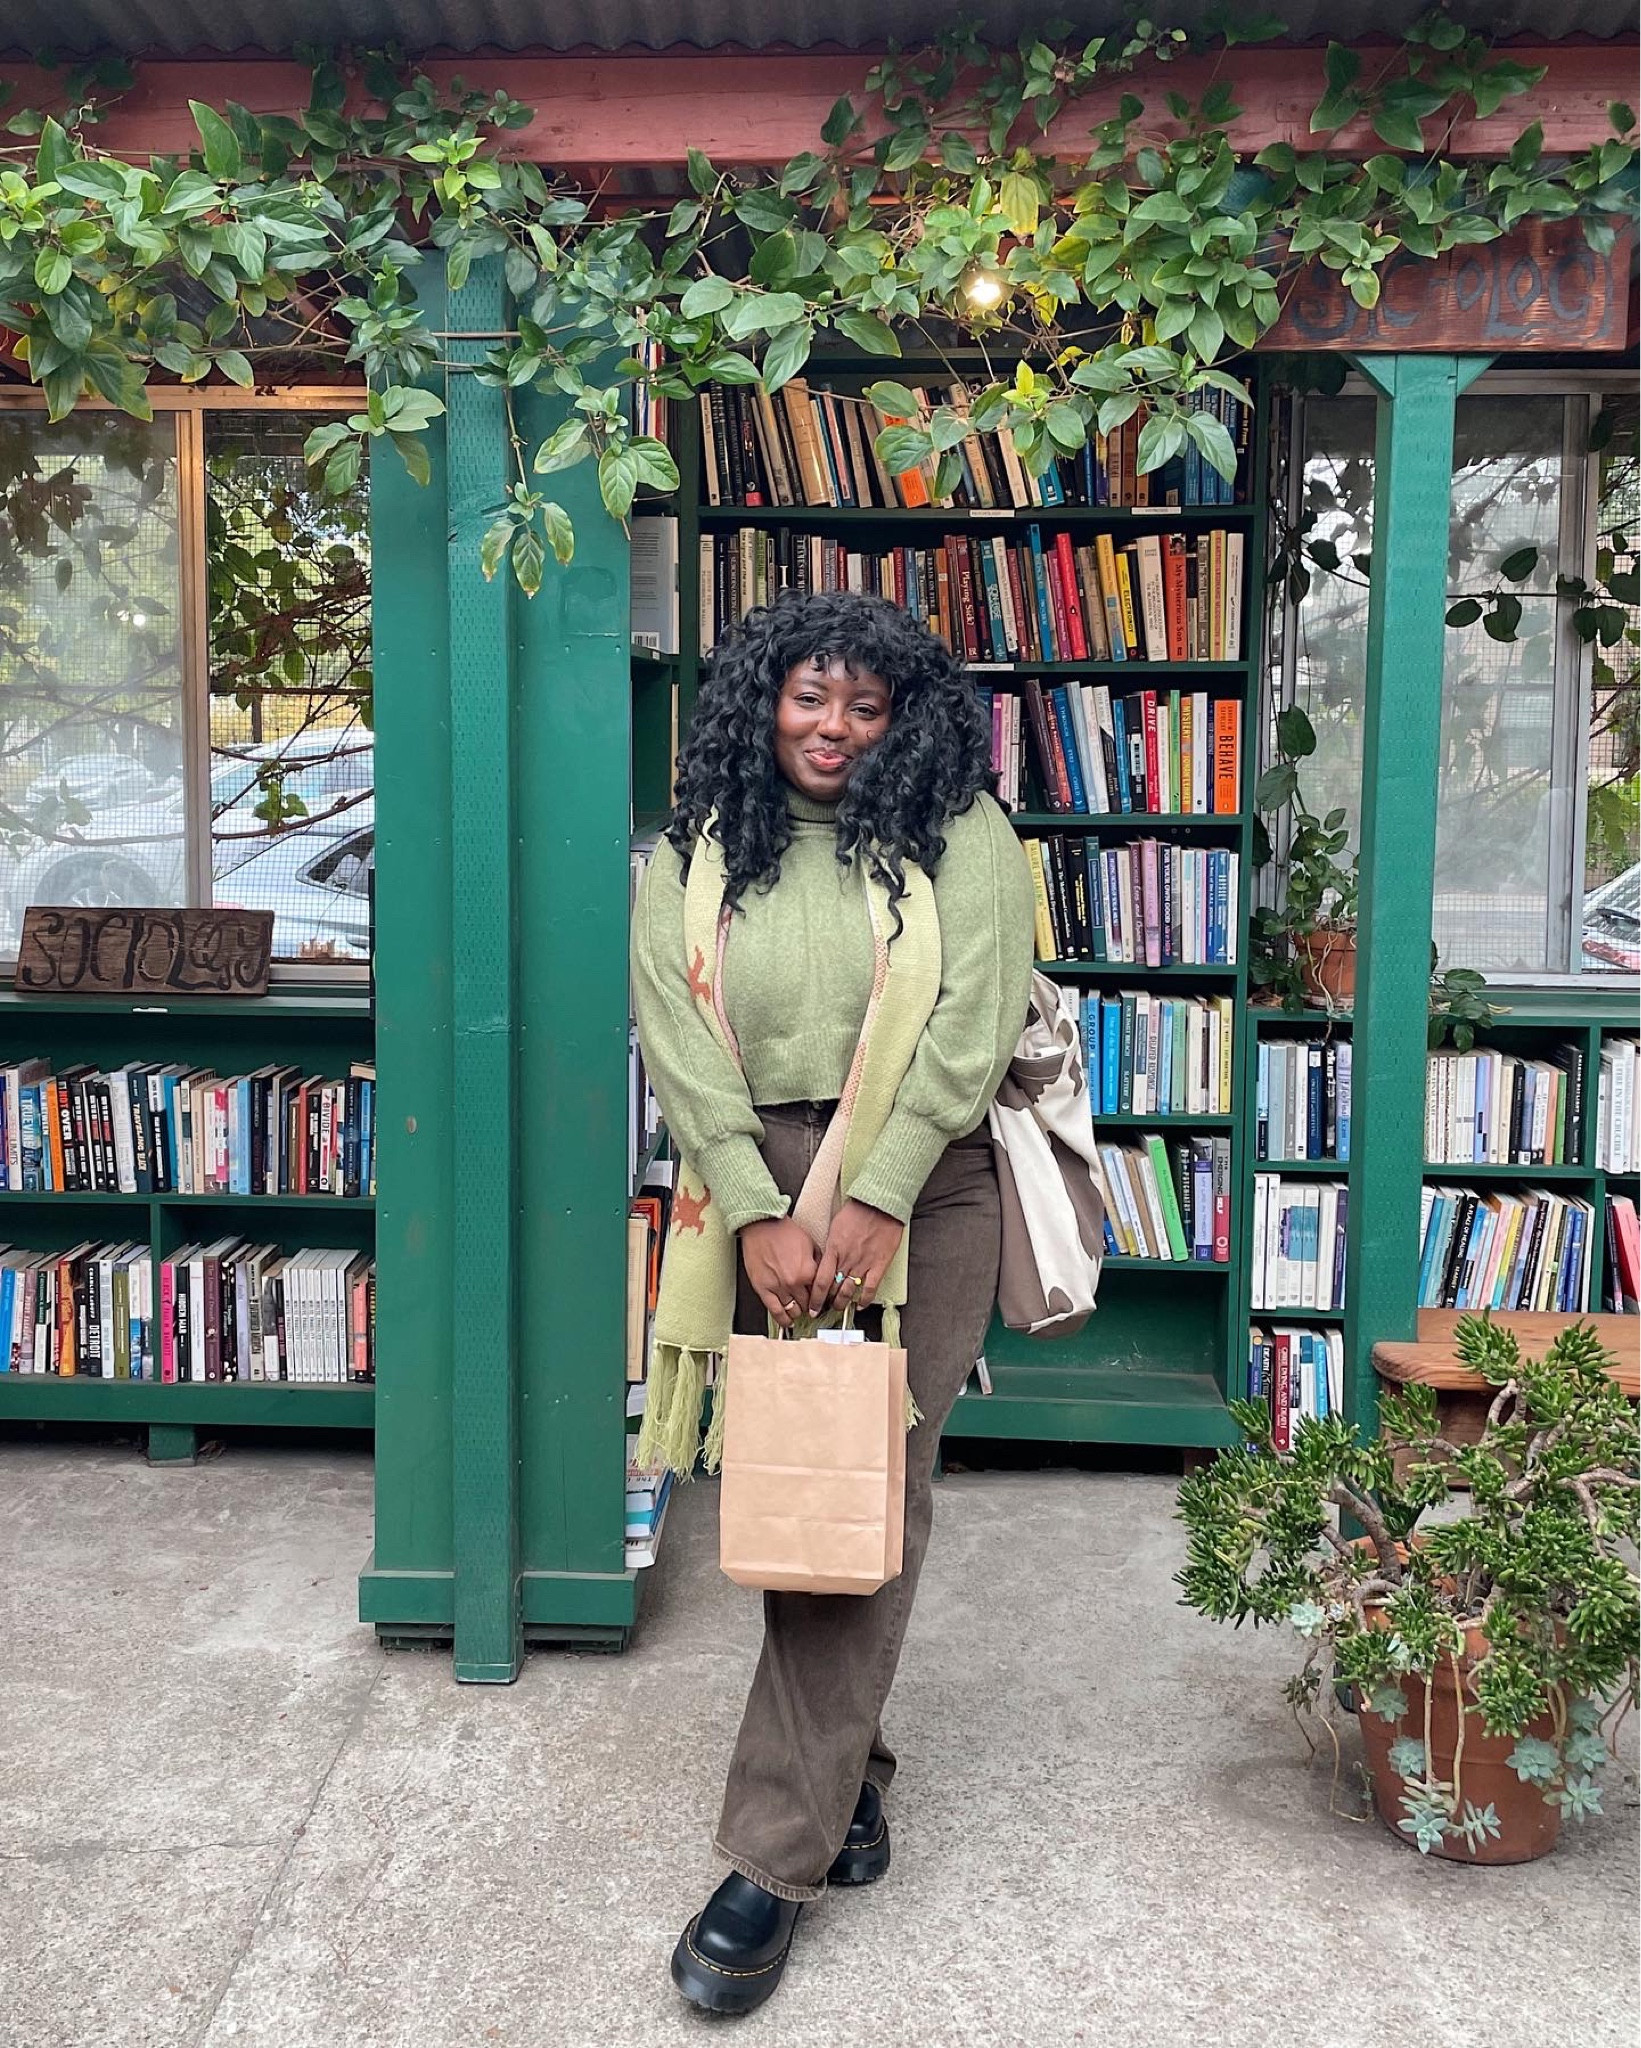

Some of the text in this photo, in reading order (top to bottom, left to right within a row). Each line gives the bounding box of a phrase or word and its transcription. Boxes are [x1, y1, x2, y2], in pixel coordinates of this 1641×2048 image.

[797, 580, 806, 593] MIN
[1174, 564, 1182, 578] My
[961, 571, 974, 625] Playing Sick?
[1174, 580, 1183, 624] Mysterious
[1147, 700, 1156, 732] DRIVE
[1182, 705, 1190, 739] MYSTERY
[1219, 735, 1234, 780] BEHAVE
[1072, 776, 1080, 796] CHILD
[1148, 1036, 1157, 1090] DELAYED RESPONSE
[1615, 1089, 1623, 1099] IN
[21, 1098, 36, 1148] TRUEVINE
[61, 1109, 72, 1140] OVER
[132, 1103, 144, 1151] TRAVELING
[1182, 1172, 1190, 1212] PSYCHIATRY
[1457, 1234, 1468, 1258] HEALING
[178, 1293, 187, 1334] HIDDEN WAR
[89, 1324, 101, 1359] DETROIT
